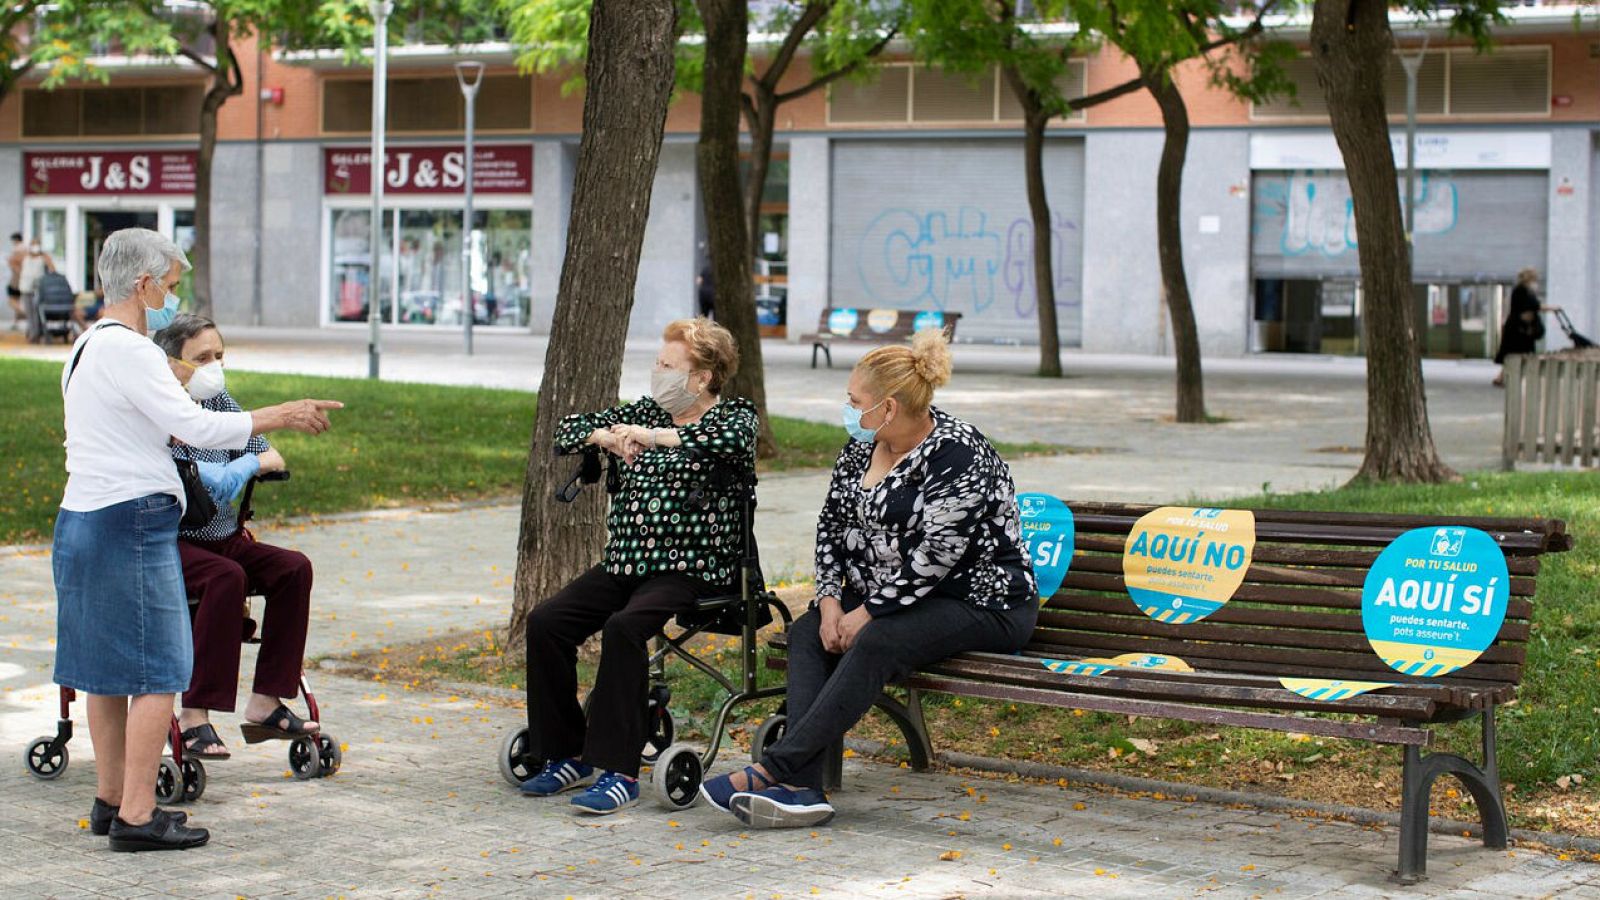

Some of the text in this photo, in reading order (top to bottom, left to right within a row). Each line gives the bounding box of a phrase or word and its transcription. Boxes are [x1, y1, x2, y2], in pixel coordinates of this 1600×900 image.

[80, 155, 150, 190] J&S
[387, 152, 464, 188] J&S
[1023, 521, 1052, 532] SALUD
[1199, 520, 1230, 533] SALUD
[1034, 534, 1066, 567] SÍ
[1129, 531, 1246, 571] AQUÍ NO
[1146, 565, 1177, 576] puedes
[1405, 558, 1478, 573] POR TU SALUD
[1374, 574, 1499, 616] AQUÍ SÍ
[1389, 615, 1470, 630] puedes sentarte.
[1393, 627, 1414, 637] pots
